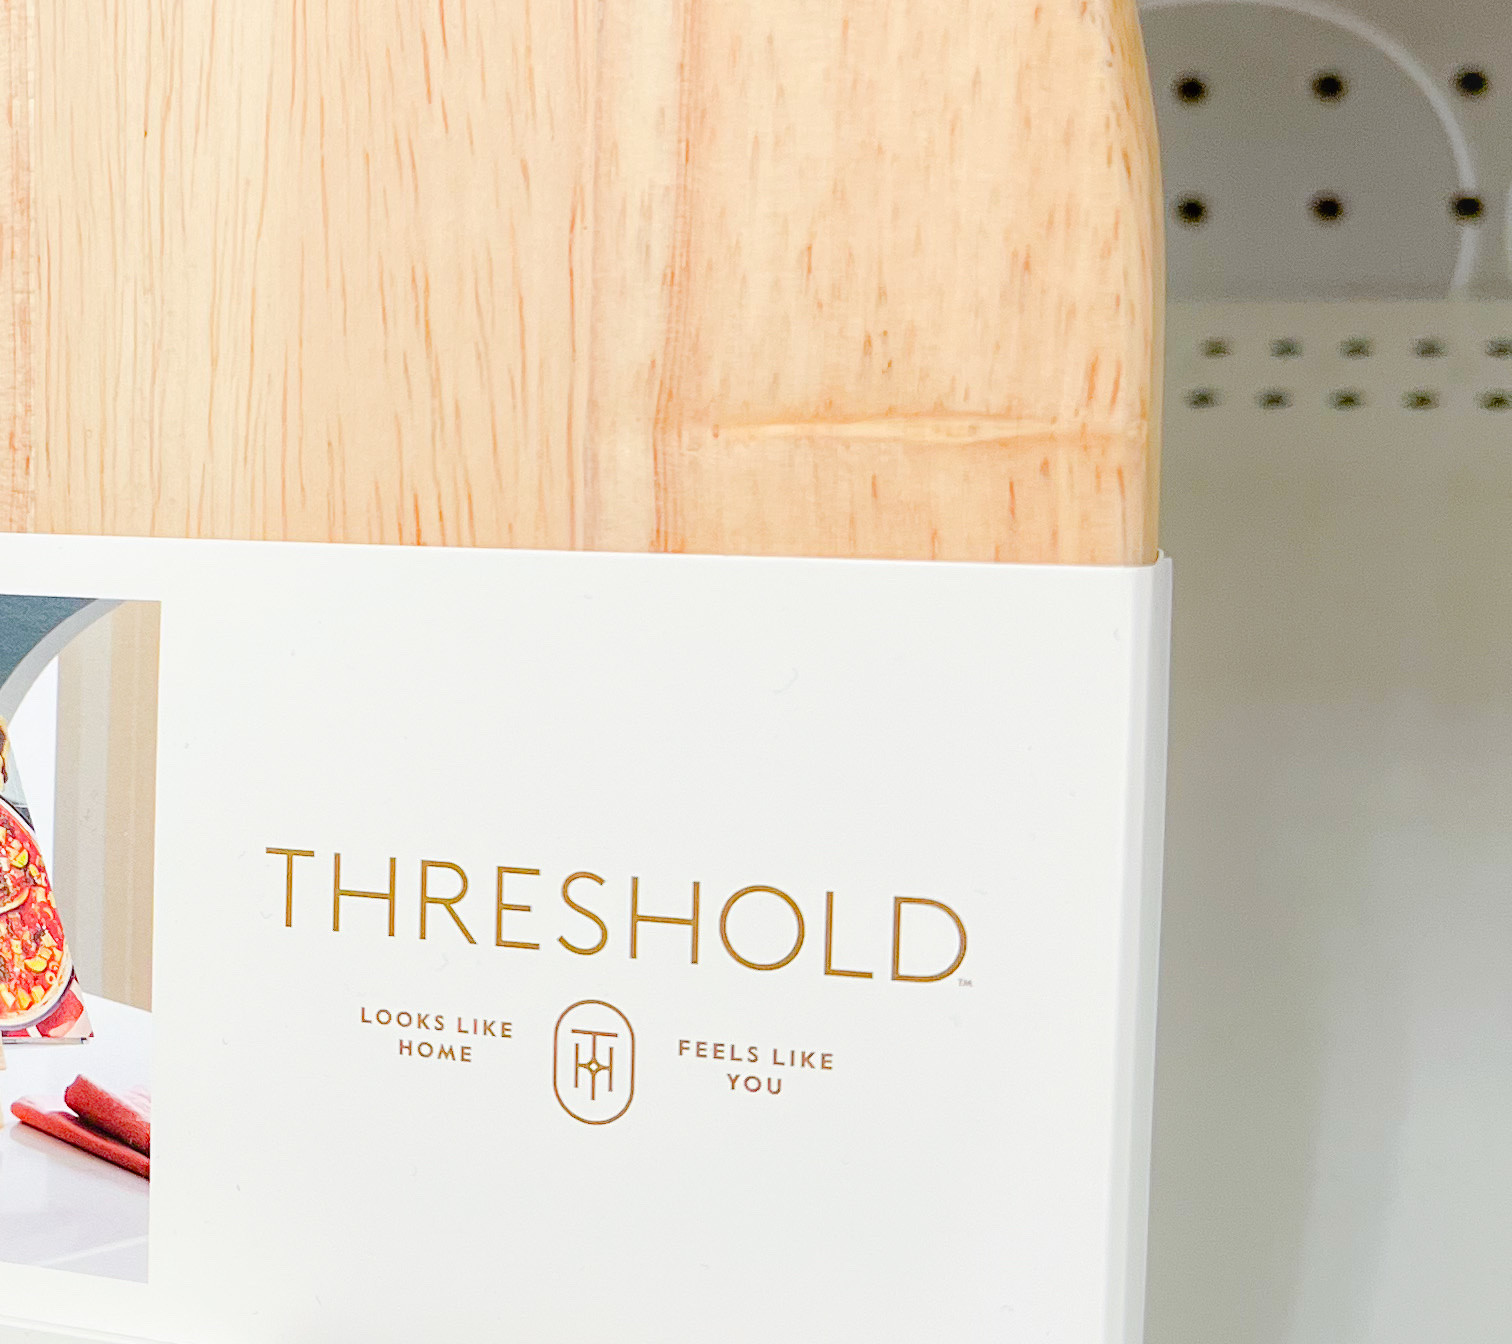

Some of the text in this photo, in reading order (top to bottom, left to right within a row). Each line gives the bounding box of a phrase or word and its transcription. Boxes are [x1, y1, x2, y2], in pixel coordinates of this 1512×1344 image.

[265, 847, 968, 983] THRESHOLD
[360, 1006, 514, 1040] LOOKS LIKE
[398, 1039, 473, 1064] HOME
[678, 1038, 835, 1072] FEELS LIKE
[726, 1073, 783, 1096] YOU
